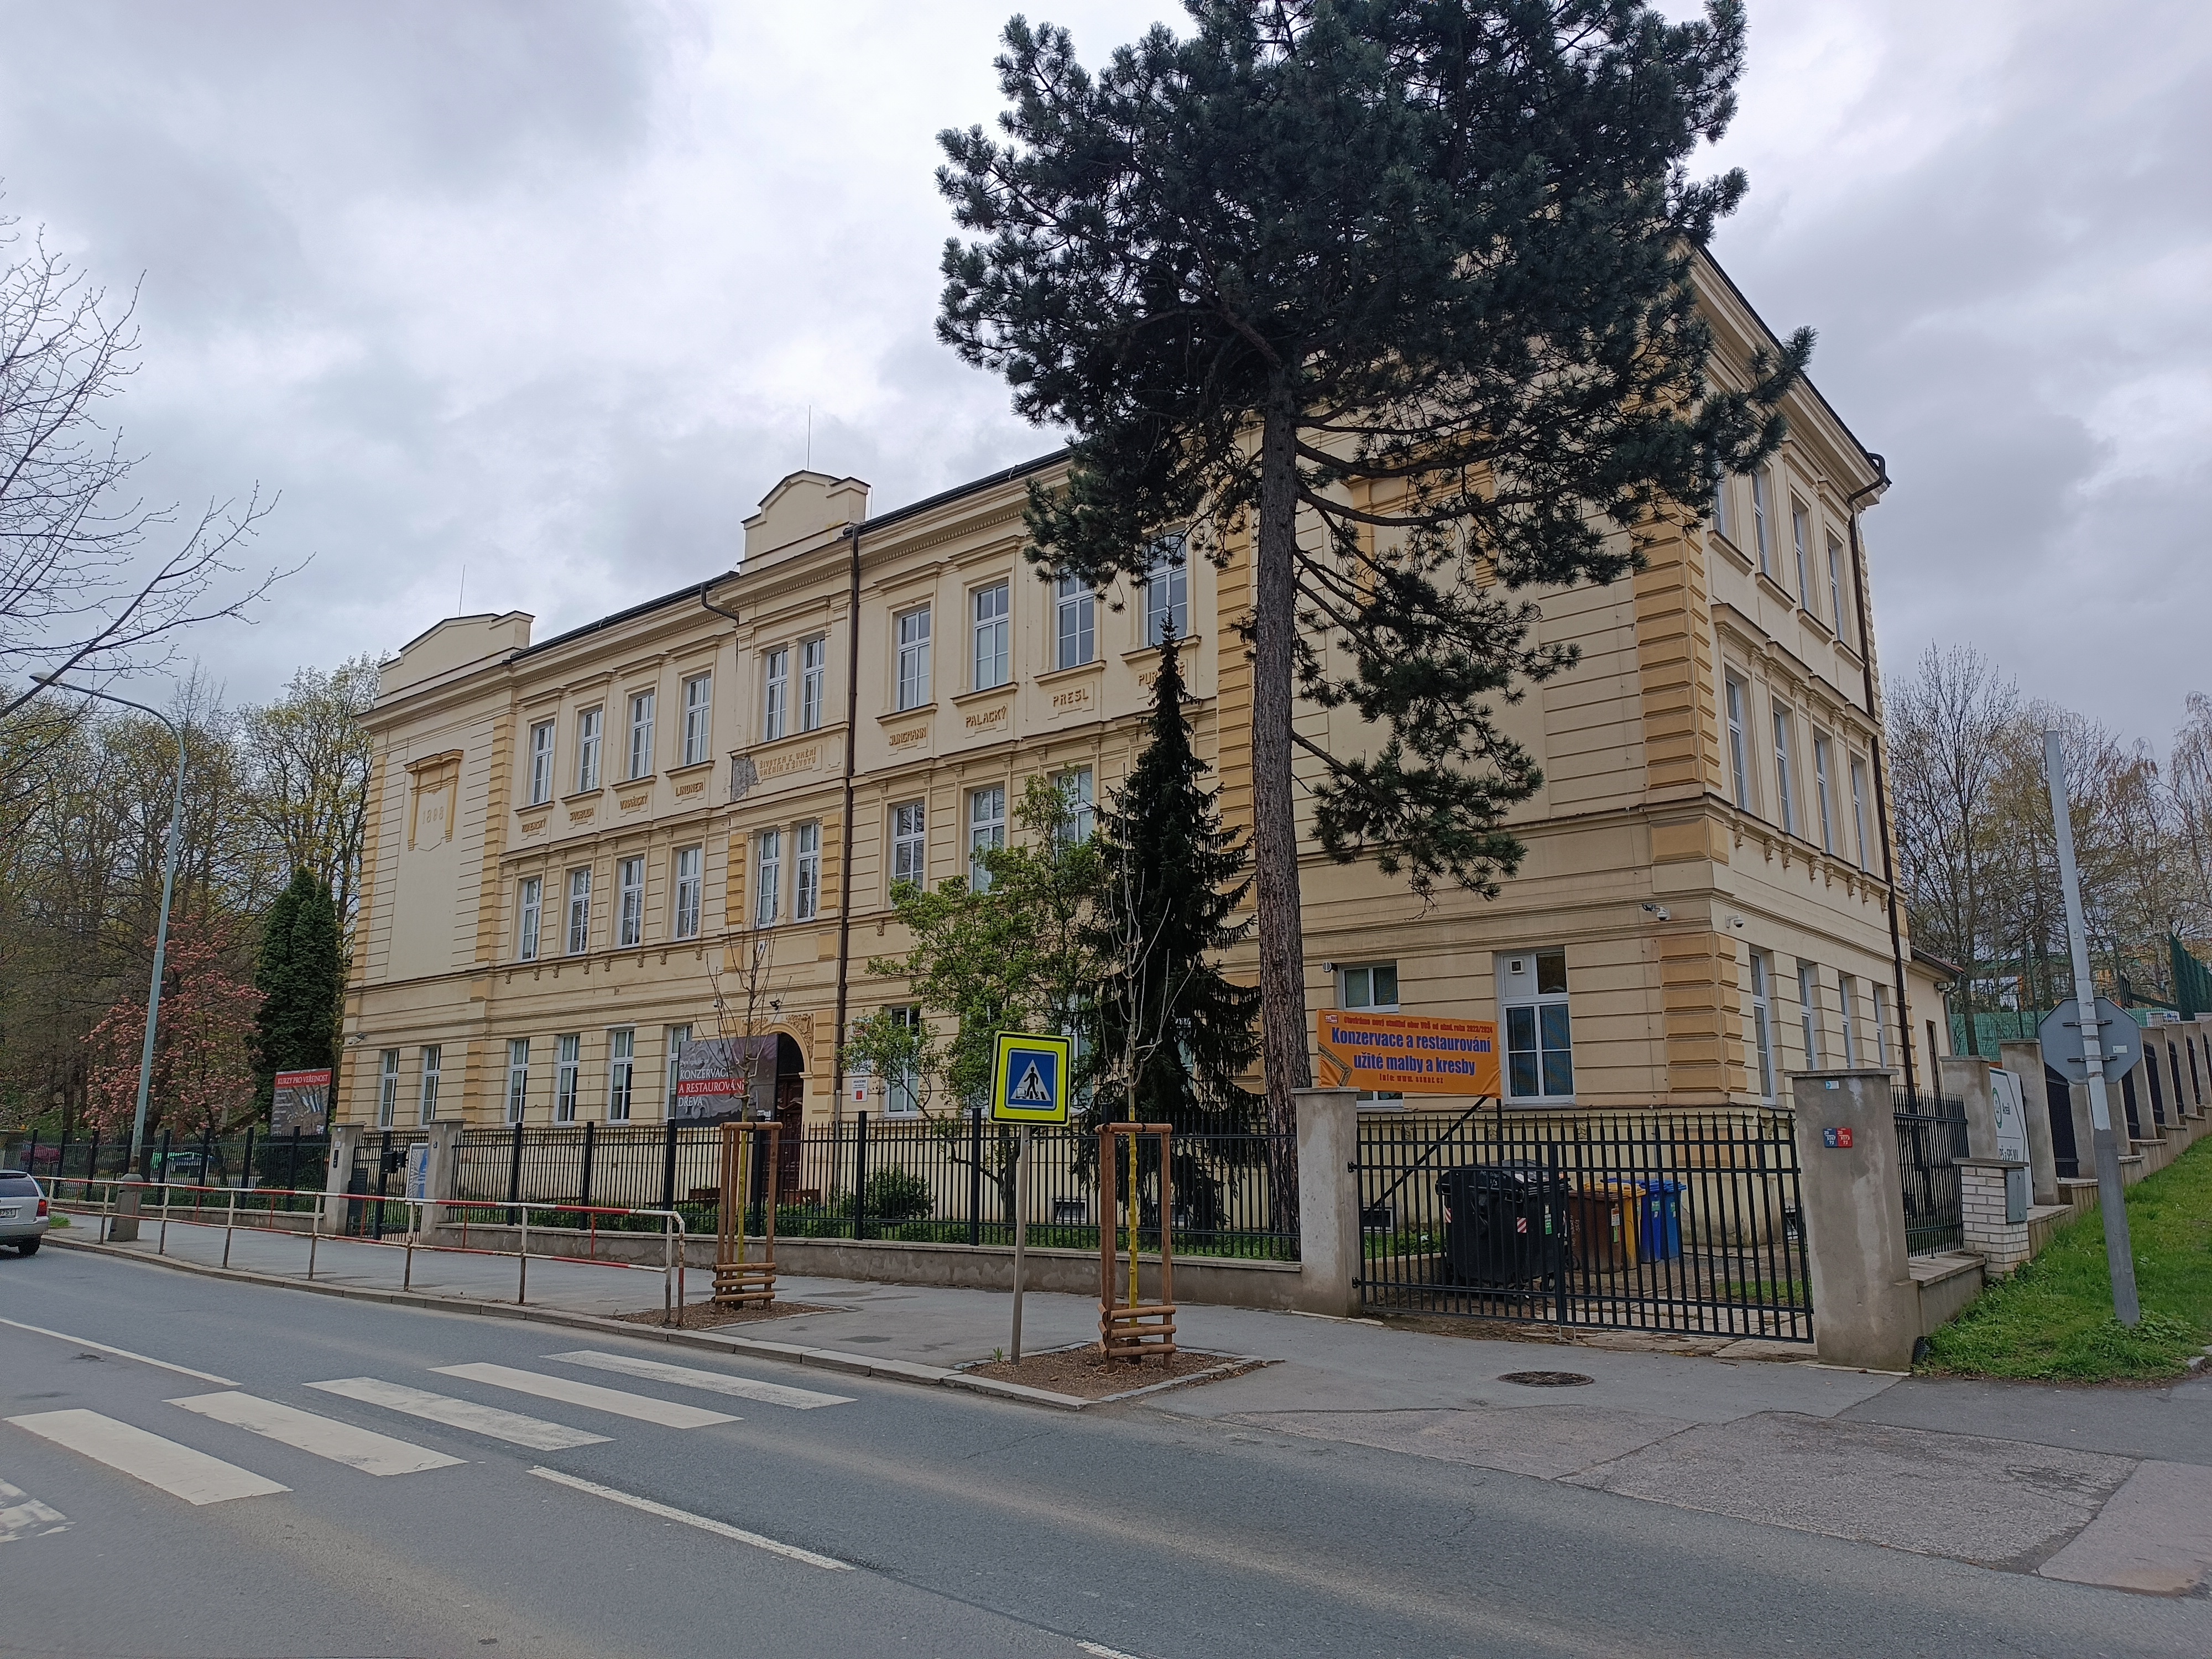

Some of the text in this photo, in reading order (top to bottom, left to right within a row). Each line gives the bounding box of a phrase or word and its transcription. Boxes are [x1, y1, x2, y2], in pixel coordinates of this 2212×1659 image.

[1053, 688, 1089, 707] PRESL
[966, 705, 1007, 728] PALACKÝ
[889, 727, 926, 746] JUNGMANN
[759, 755, 786, 769] ŽIVOTEM
[796, 747, 816, 760] UMĚNÍ
[791, 756, 816, 769] ŽIVOTU
[675, 781, 703, 797] LINDNER
[1332, 1027, 1491, 1053] Konzervace a restaurování
[1353, 1052, 1475, 1076] užité malby a kresby
[302, 1074, 328, 1083] VEŘEJNOST
[678, 1084, 684, 1093] A
[678, 1095, 703, 1107] DŘEVA
